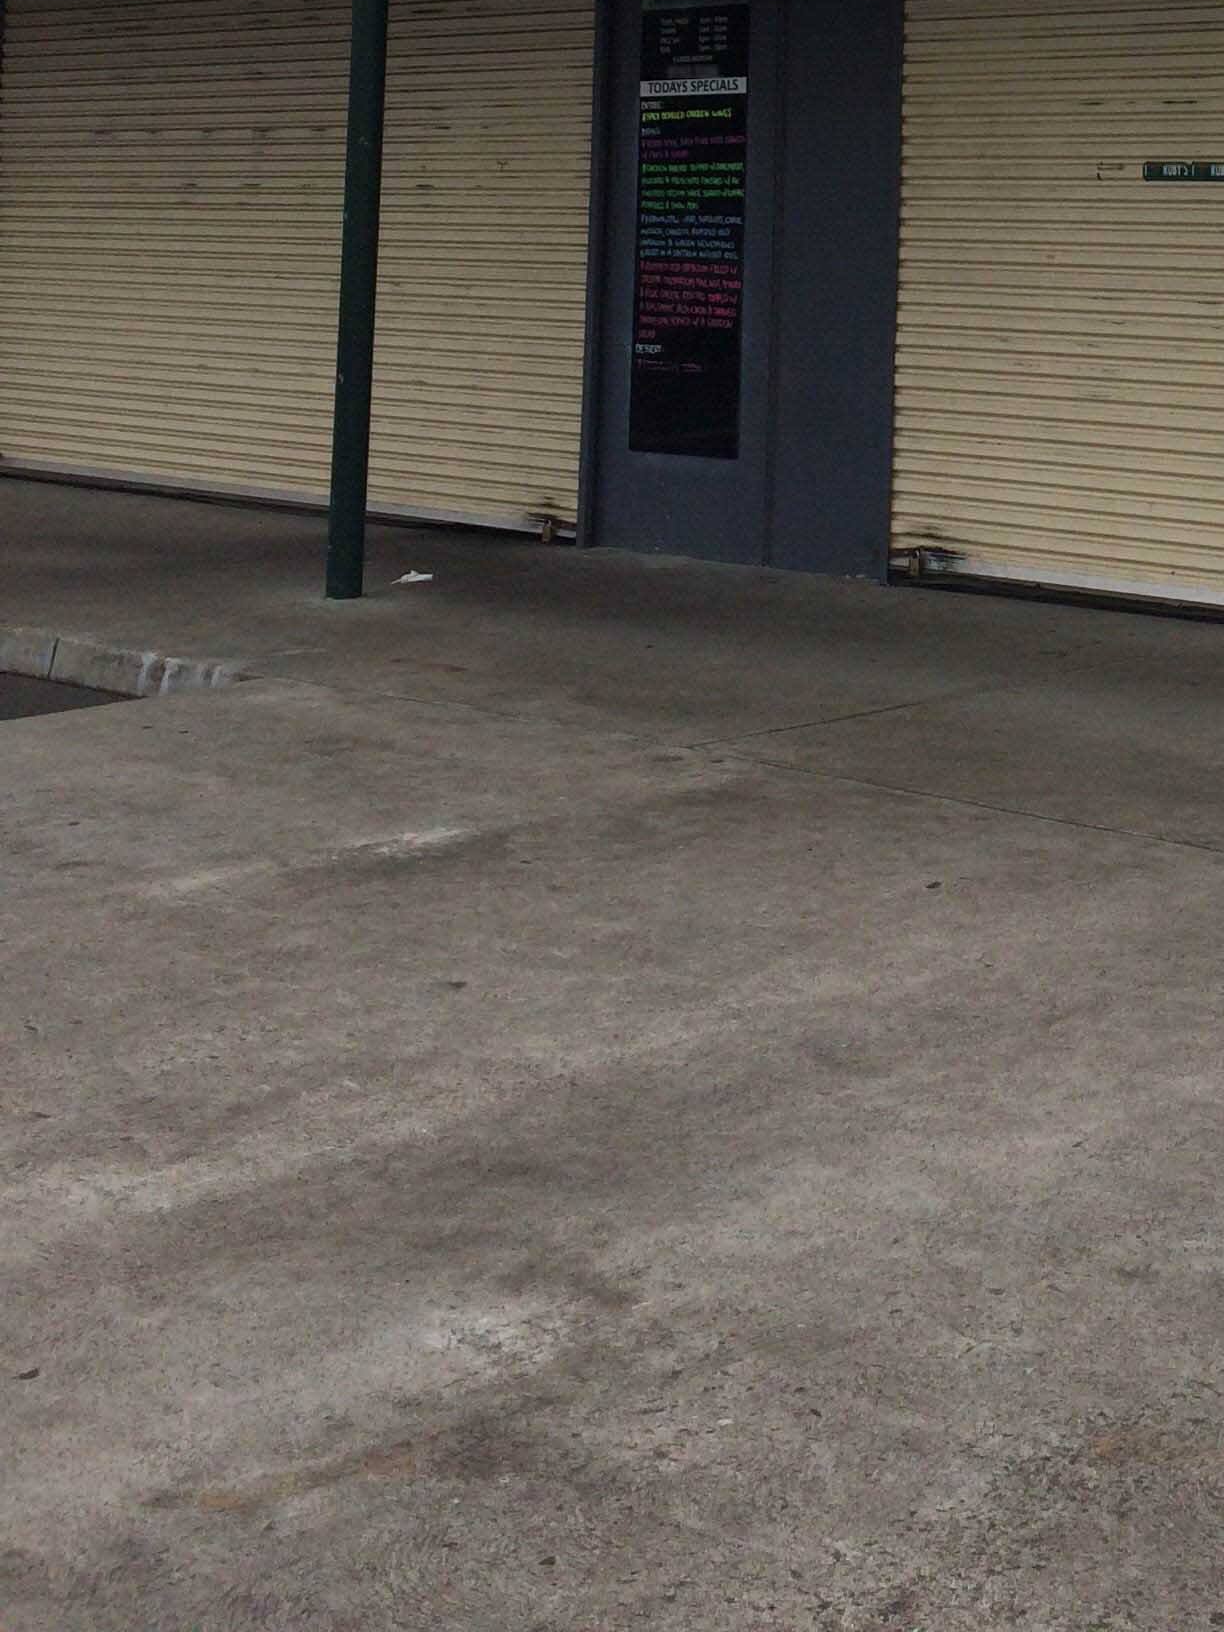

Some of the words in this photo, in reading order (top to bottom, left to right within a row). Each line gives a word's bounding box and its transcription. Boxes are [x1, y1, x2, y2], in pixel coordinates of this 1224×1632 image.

[648, 81, 689, 94] TODAYS
[690, 78, 739, 93] SPECIALS
[1163, 164, 1188, 177] RUBY'S
